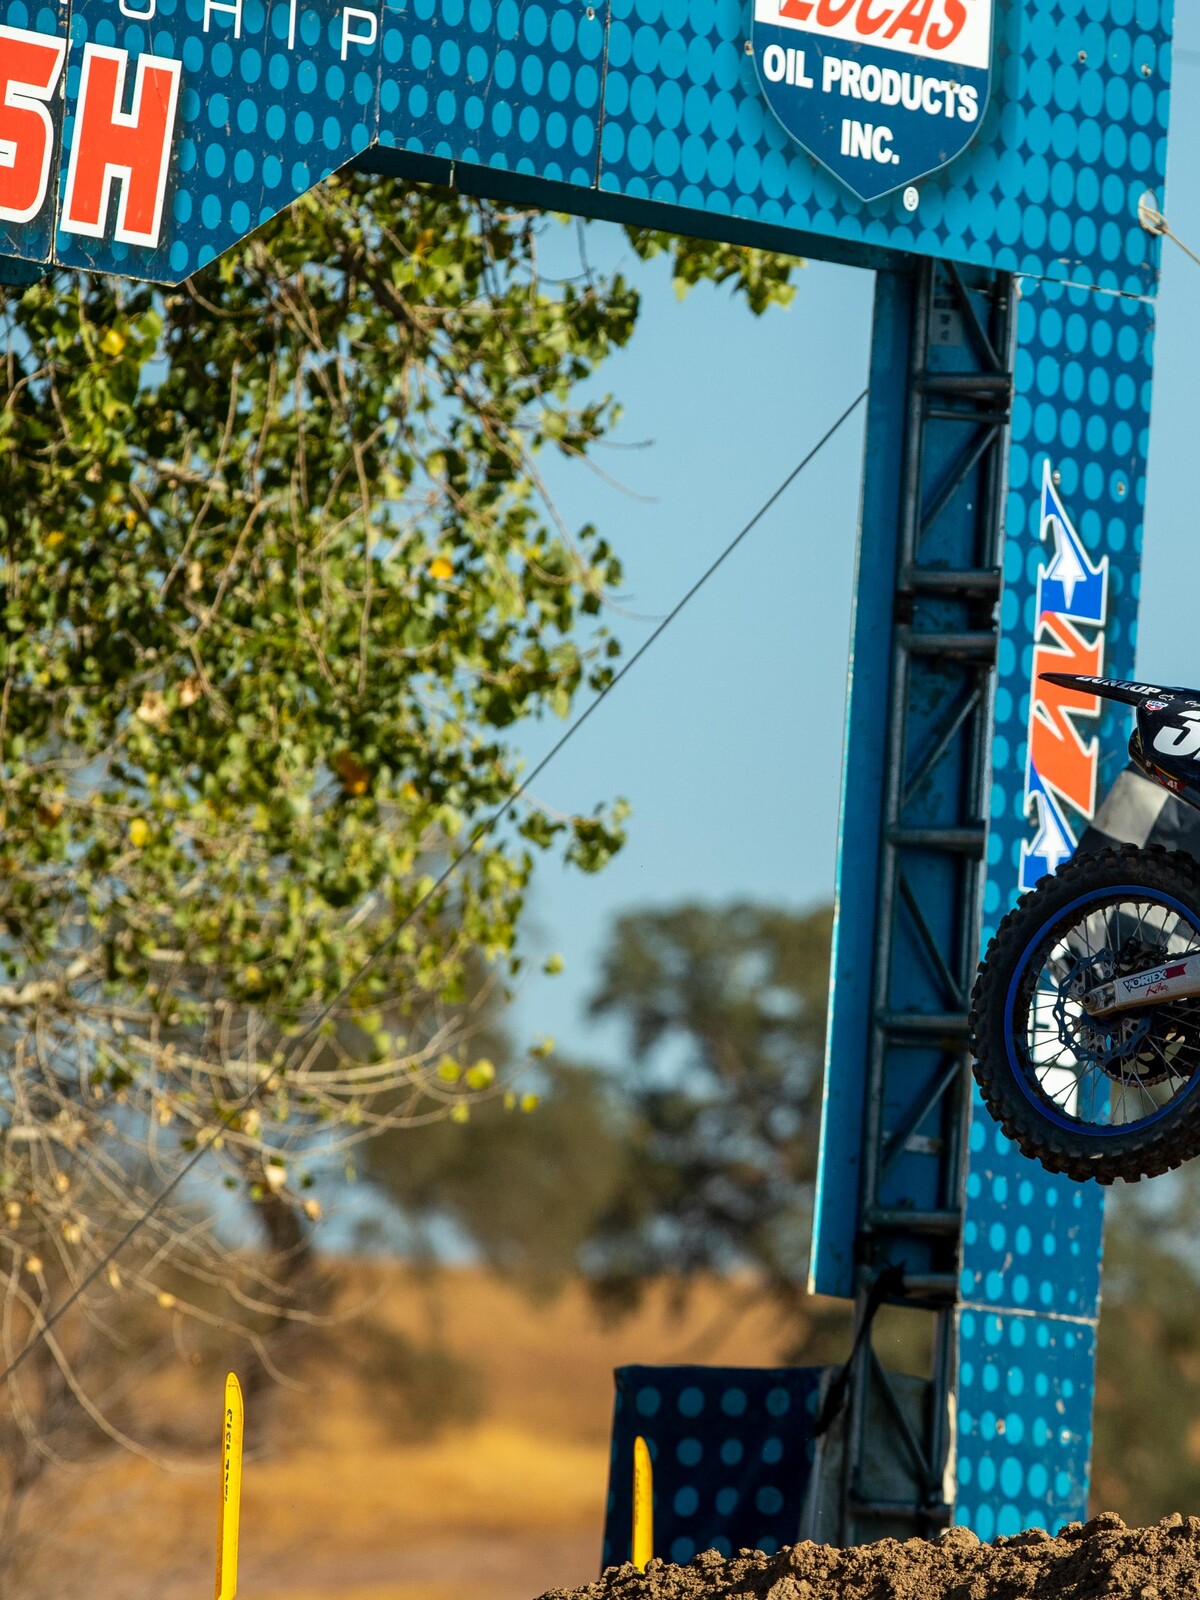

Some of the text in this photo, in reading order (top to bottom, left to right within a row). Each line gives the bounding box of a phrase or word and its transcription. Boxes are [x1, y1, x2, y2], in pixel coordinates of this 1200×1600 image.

[778, 0, 968, 50] CAS
[763, 45, 978, 122] OIL PRODUCTS
[841, 119, 900, 165] INC.
[1122, 968, 1168, 994] VORTEX
